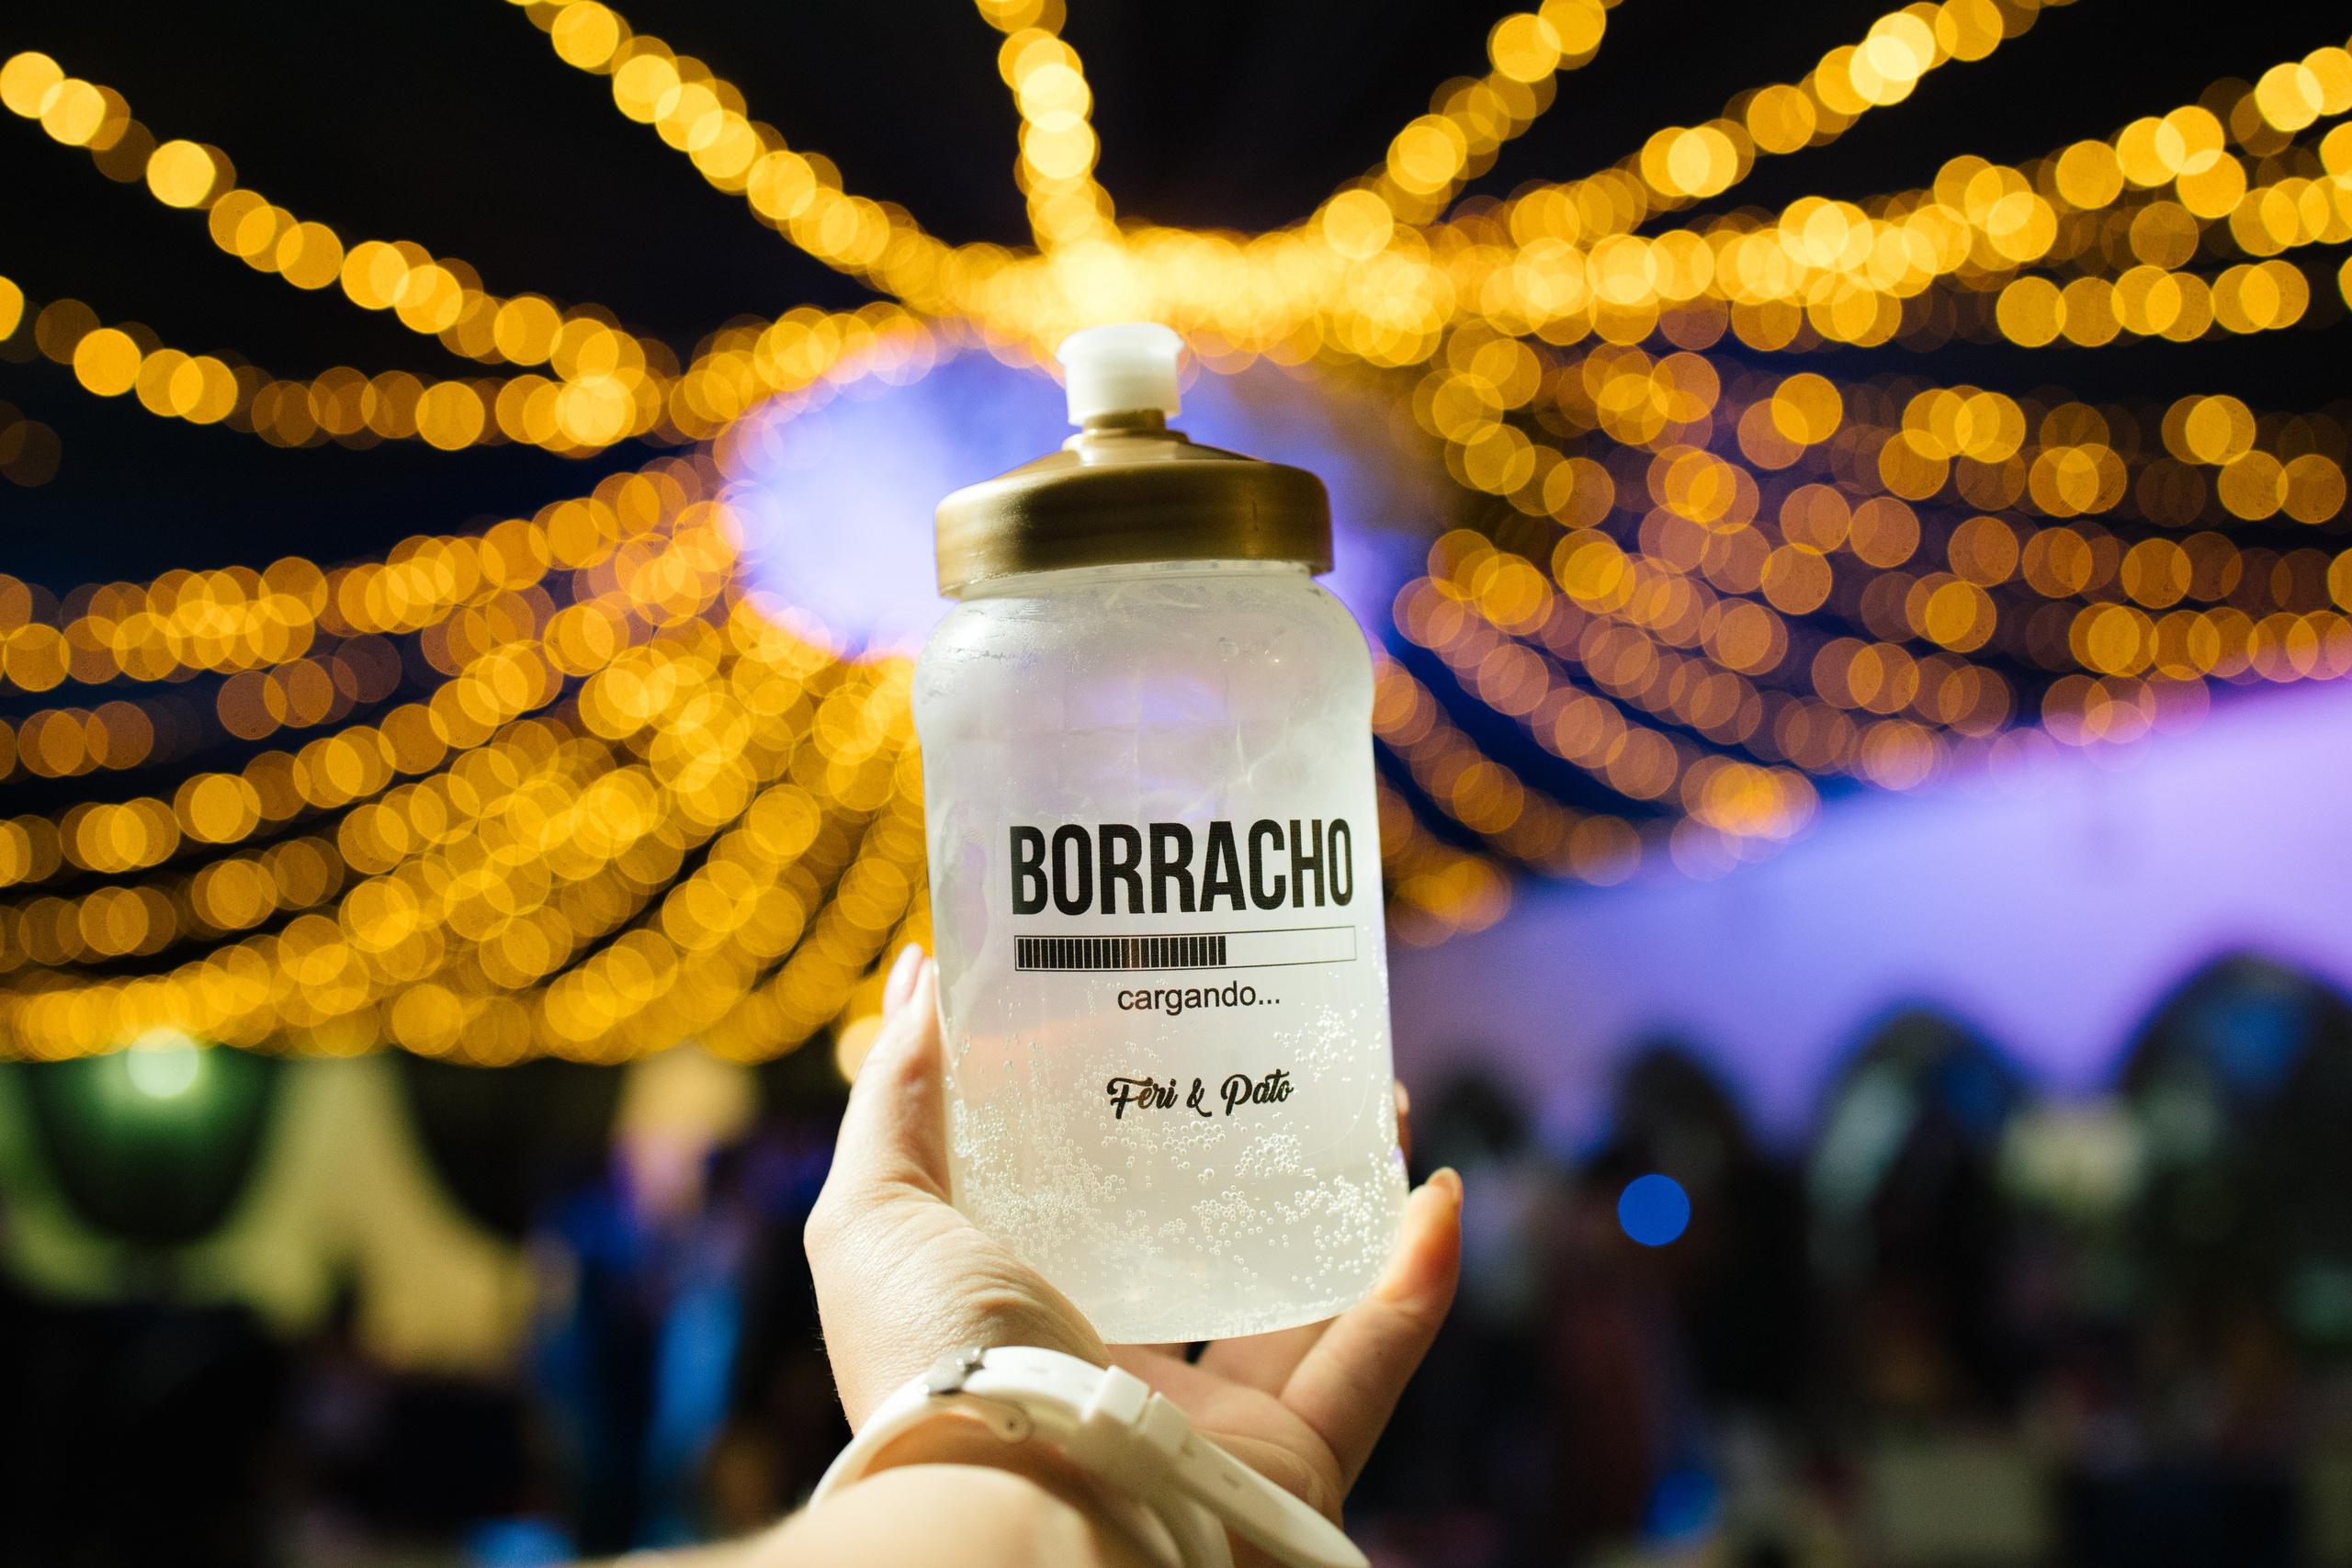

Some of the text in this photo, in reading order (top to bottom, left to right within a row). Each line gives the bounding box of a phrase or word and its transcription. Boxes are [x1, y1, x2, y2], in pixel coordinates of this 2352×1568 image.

[1010, 818, 1353, 916] BORRACHO
[1117, 980, 1281, 1016] cargando...
[1106, 1068, 1295, 1120] Feri & Pato
